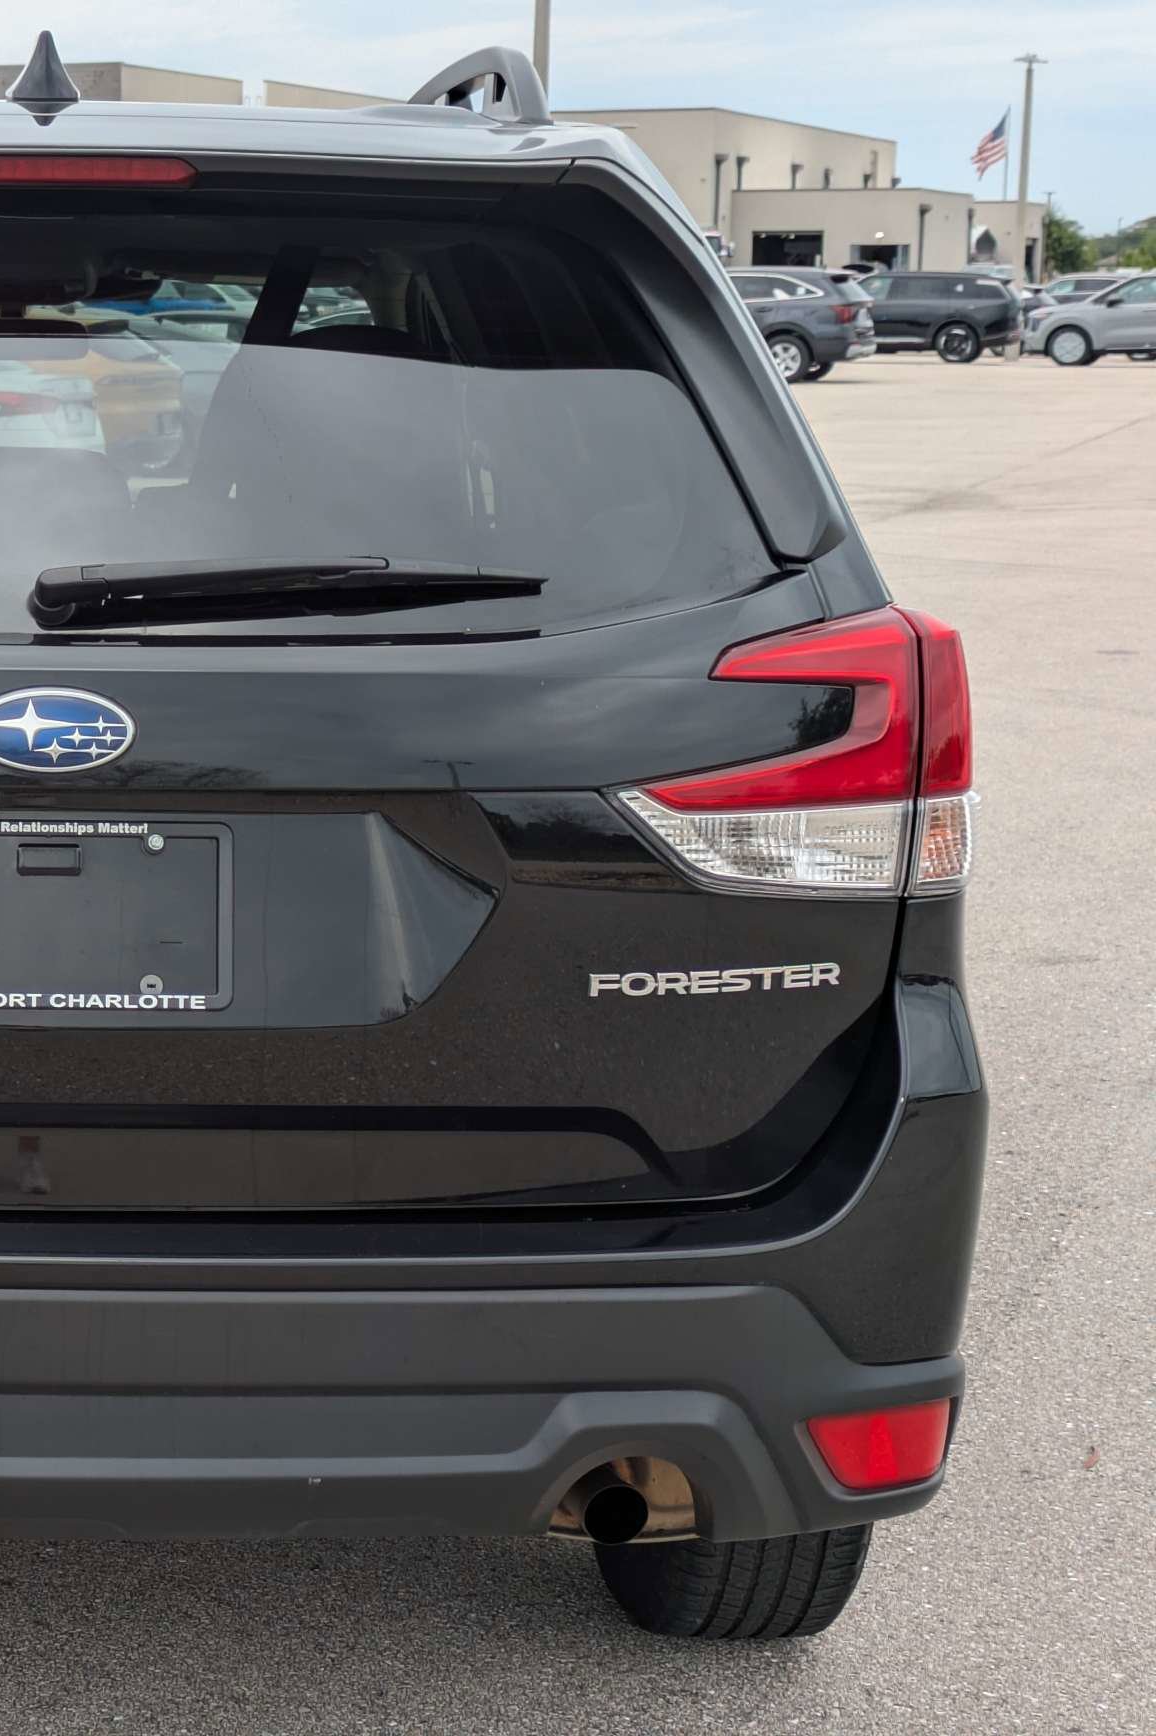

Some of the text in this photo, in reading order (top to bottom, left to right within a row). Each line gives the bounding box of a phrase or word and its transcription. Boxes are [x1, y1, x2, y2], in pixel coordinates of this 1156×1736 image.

[0, 821, 95, 836] Relationships
[97, 822, 149, 834] Matter!
[589, 962, 842, 998] FORESTER
[49, 993, 207, 1010] CHARLOTTE
